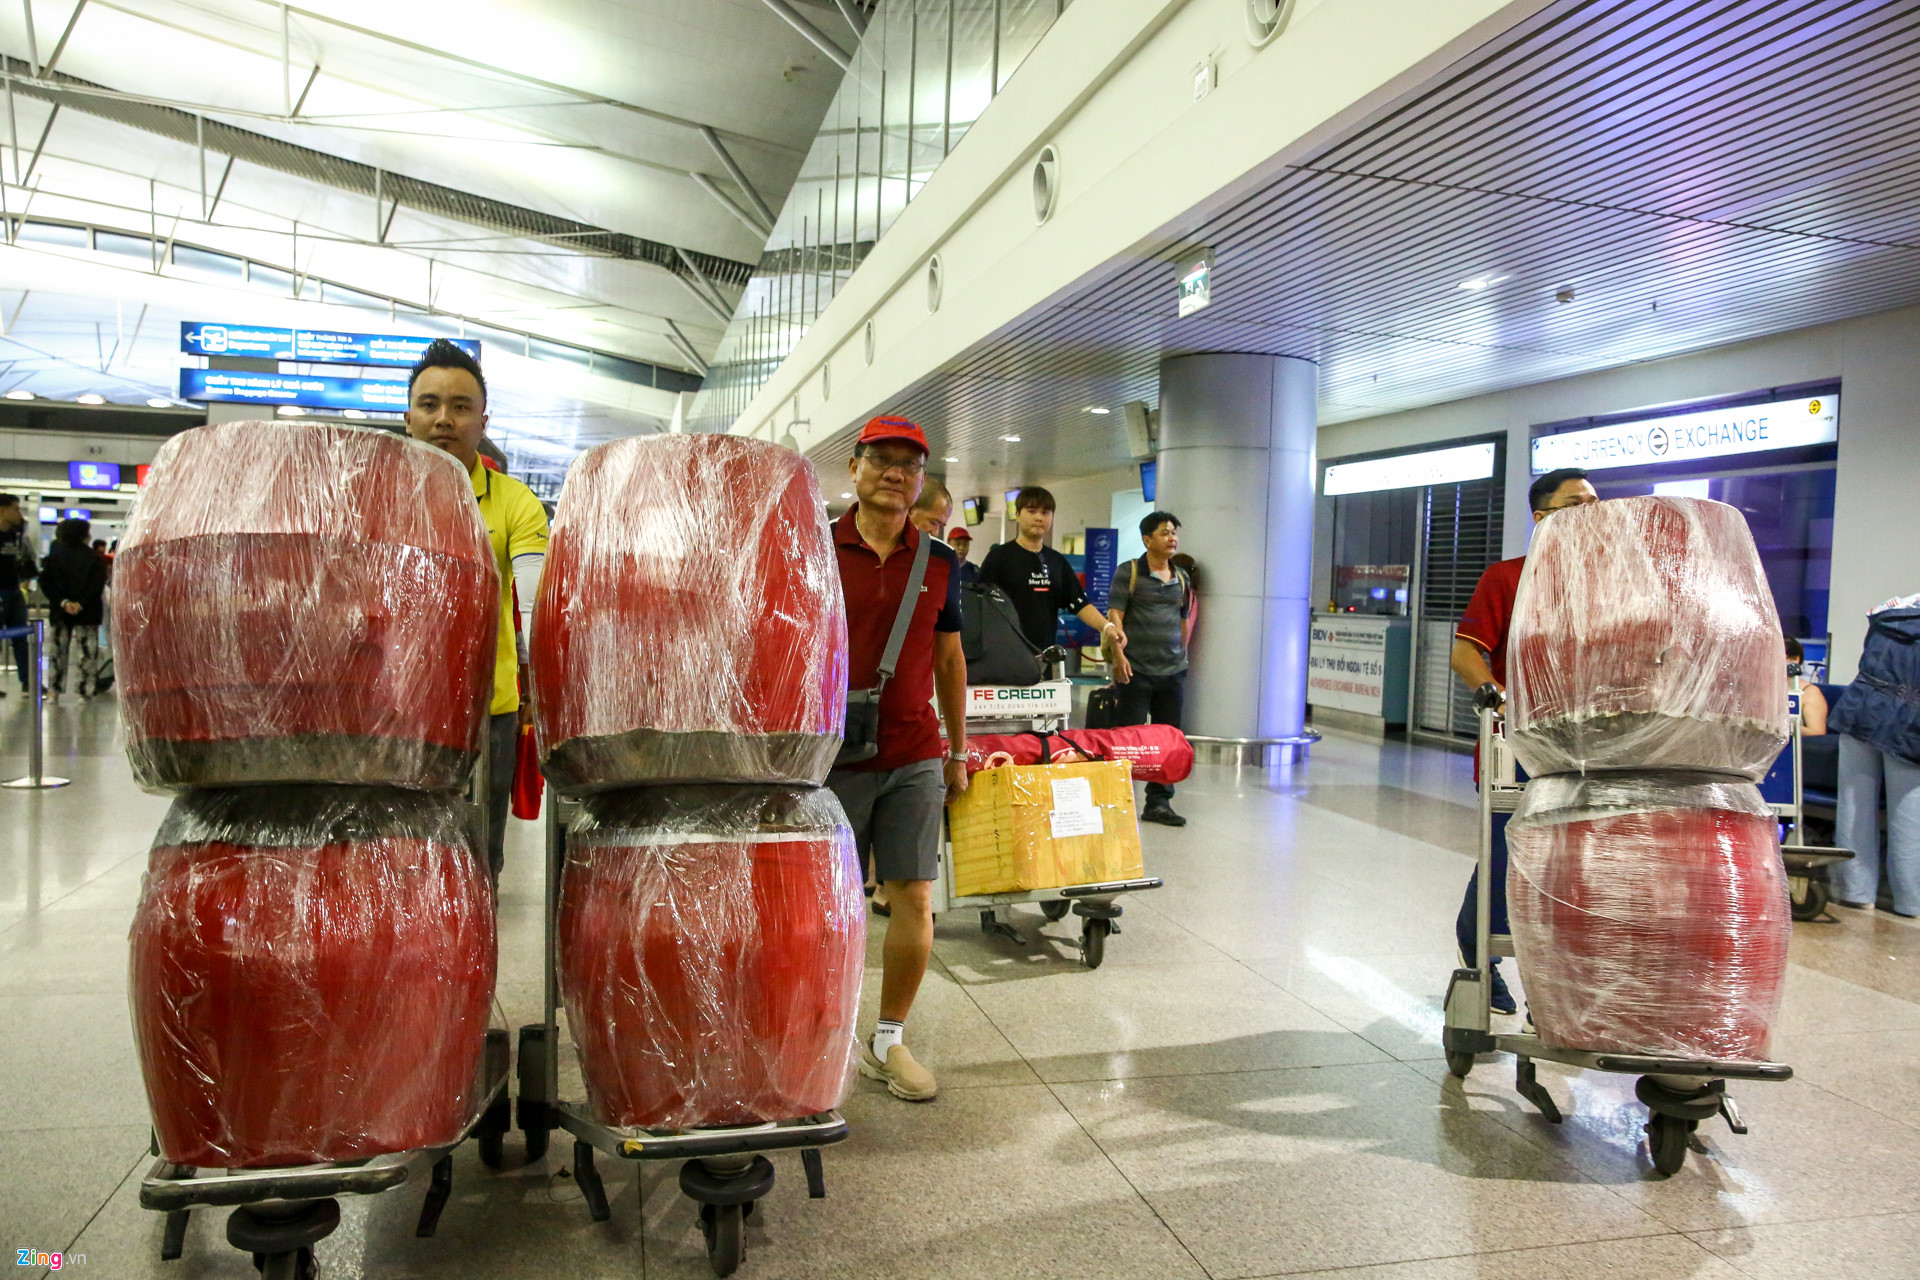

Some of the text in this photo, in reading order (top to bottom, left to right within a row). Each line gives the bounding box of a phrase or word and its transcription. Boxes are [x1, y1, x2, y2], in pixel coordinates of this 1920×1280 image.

[1573, 432, 1644, 461] CURRENCY
[1675, 417, 1769, 449] EXCHANGE
[1312, 628, 1328, 641] BIDV
[973, 688, 1056, 700] FE CREDIT
